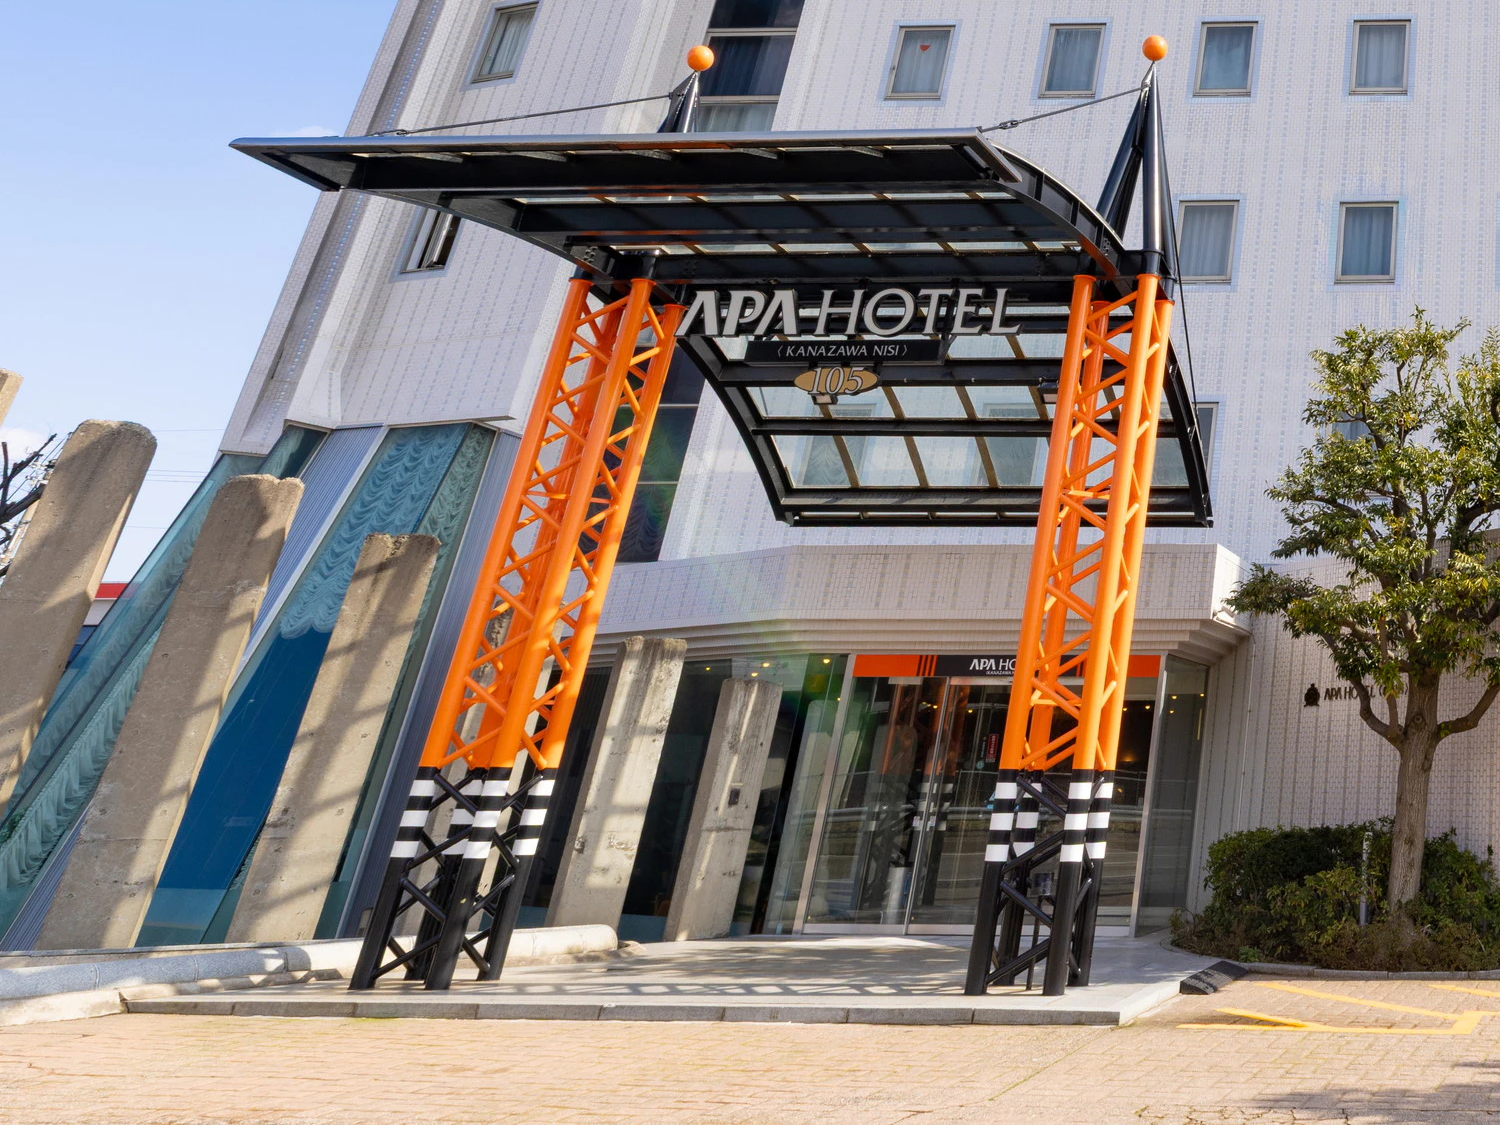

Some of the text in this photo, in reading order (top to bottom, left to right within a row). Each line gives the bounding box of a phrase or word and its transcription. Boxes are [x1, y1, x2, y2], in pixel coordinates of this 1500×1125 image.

[673, 288, 1024, 337] APA HOTEL
[807, 366, 865, 396] 105
[970, 659, 996, 670] APA
[1324, 688, 1341, 700] APA
